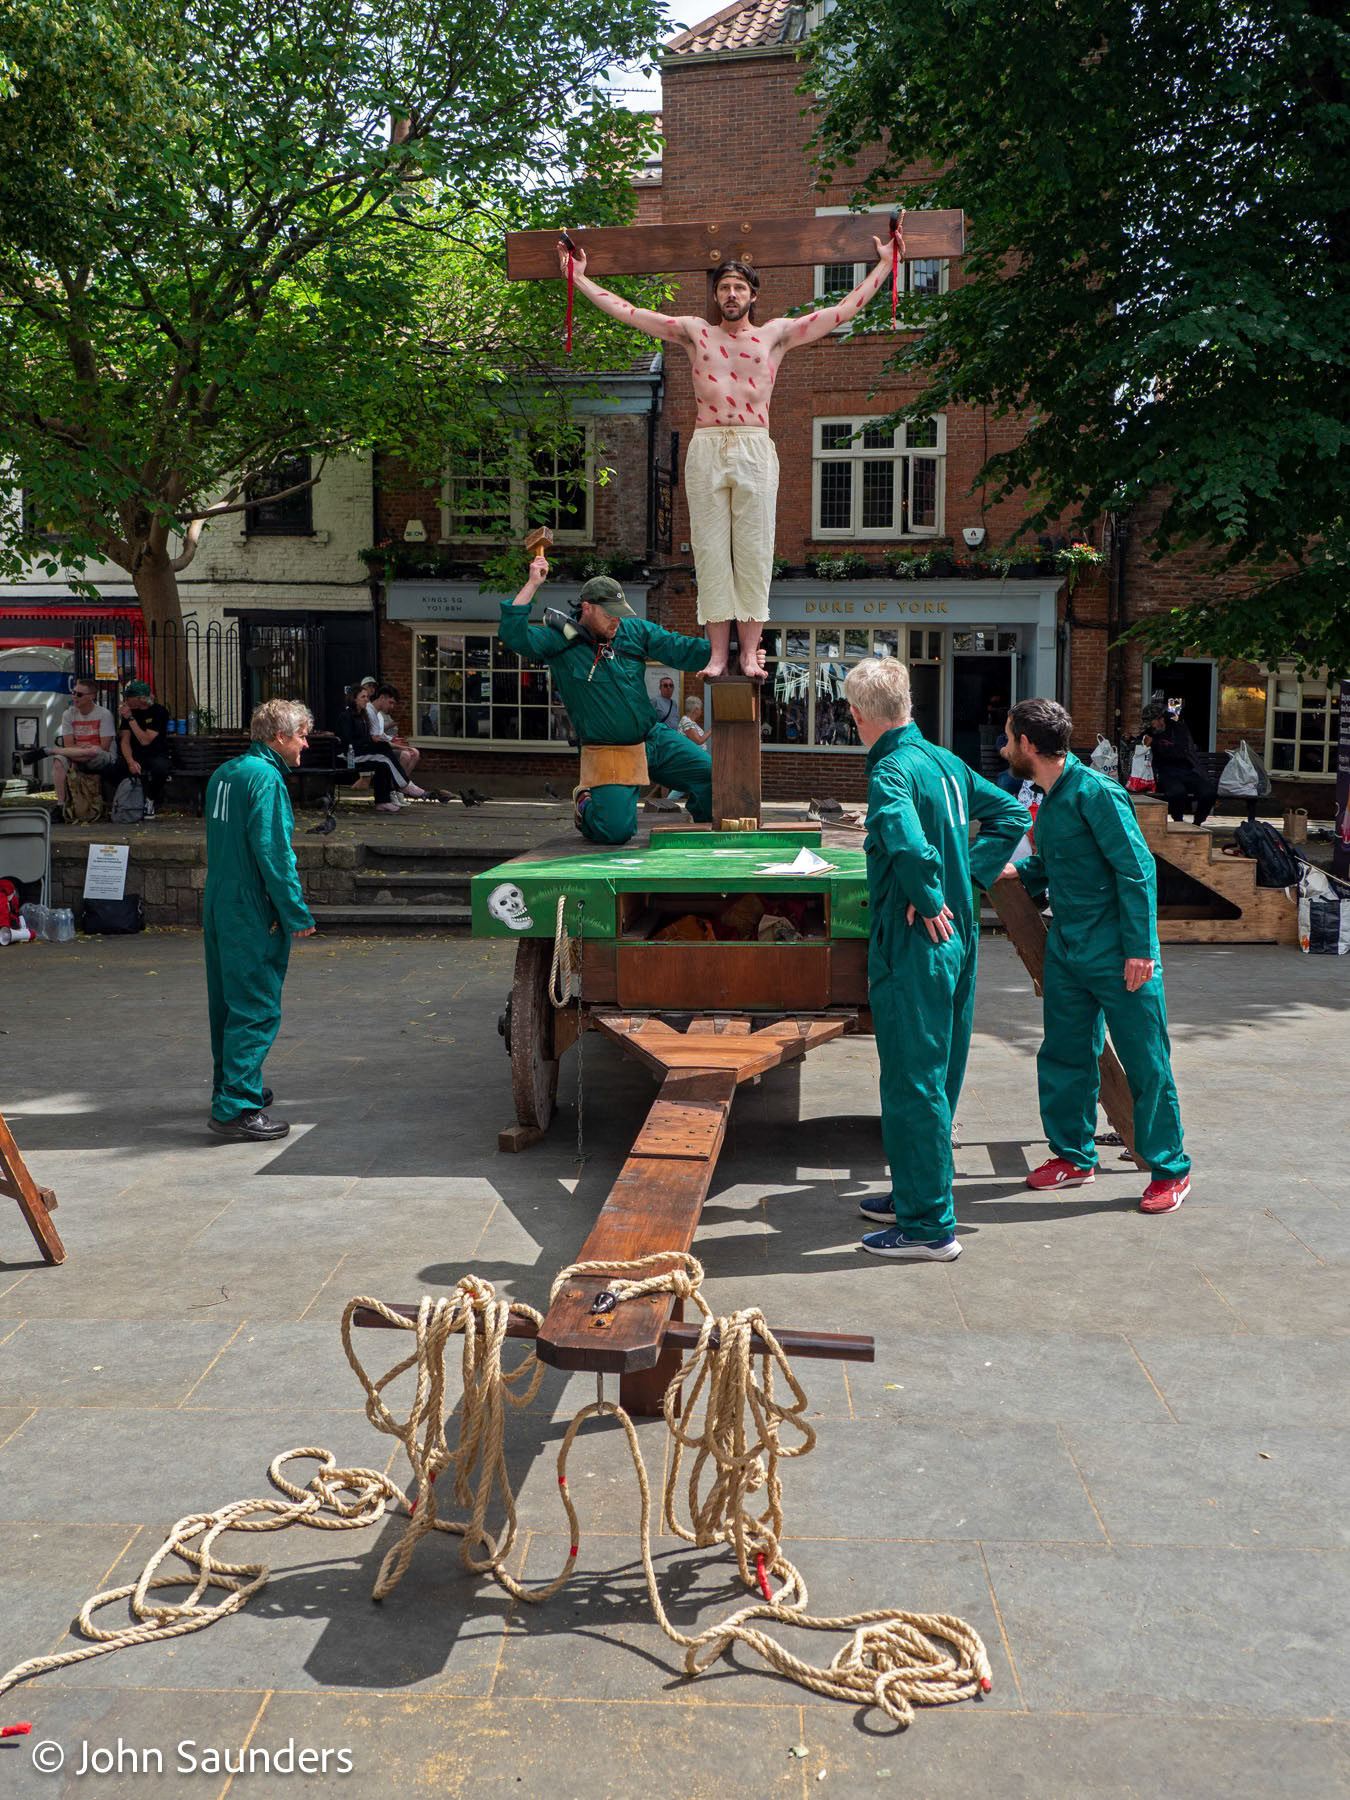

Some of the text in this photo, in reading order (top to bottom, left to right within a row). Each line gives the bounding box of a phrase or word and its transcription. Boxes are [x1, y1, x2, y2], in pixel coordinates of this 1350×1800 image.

[805, 600, 949, 614] DUKE OF YORK
